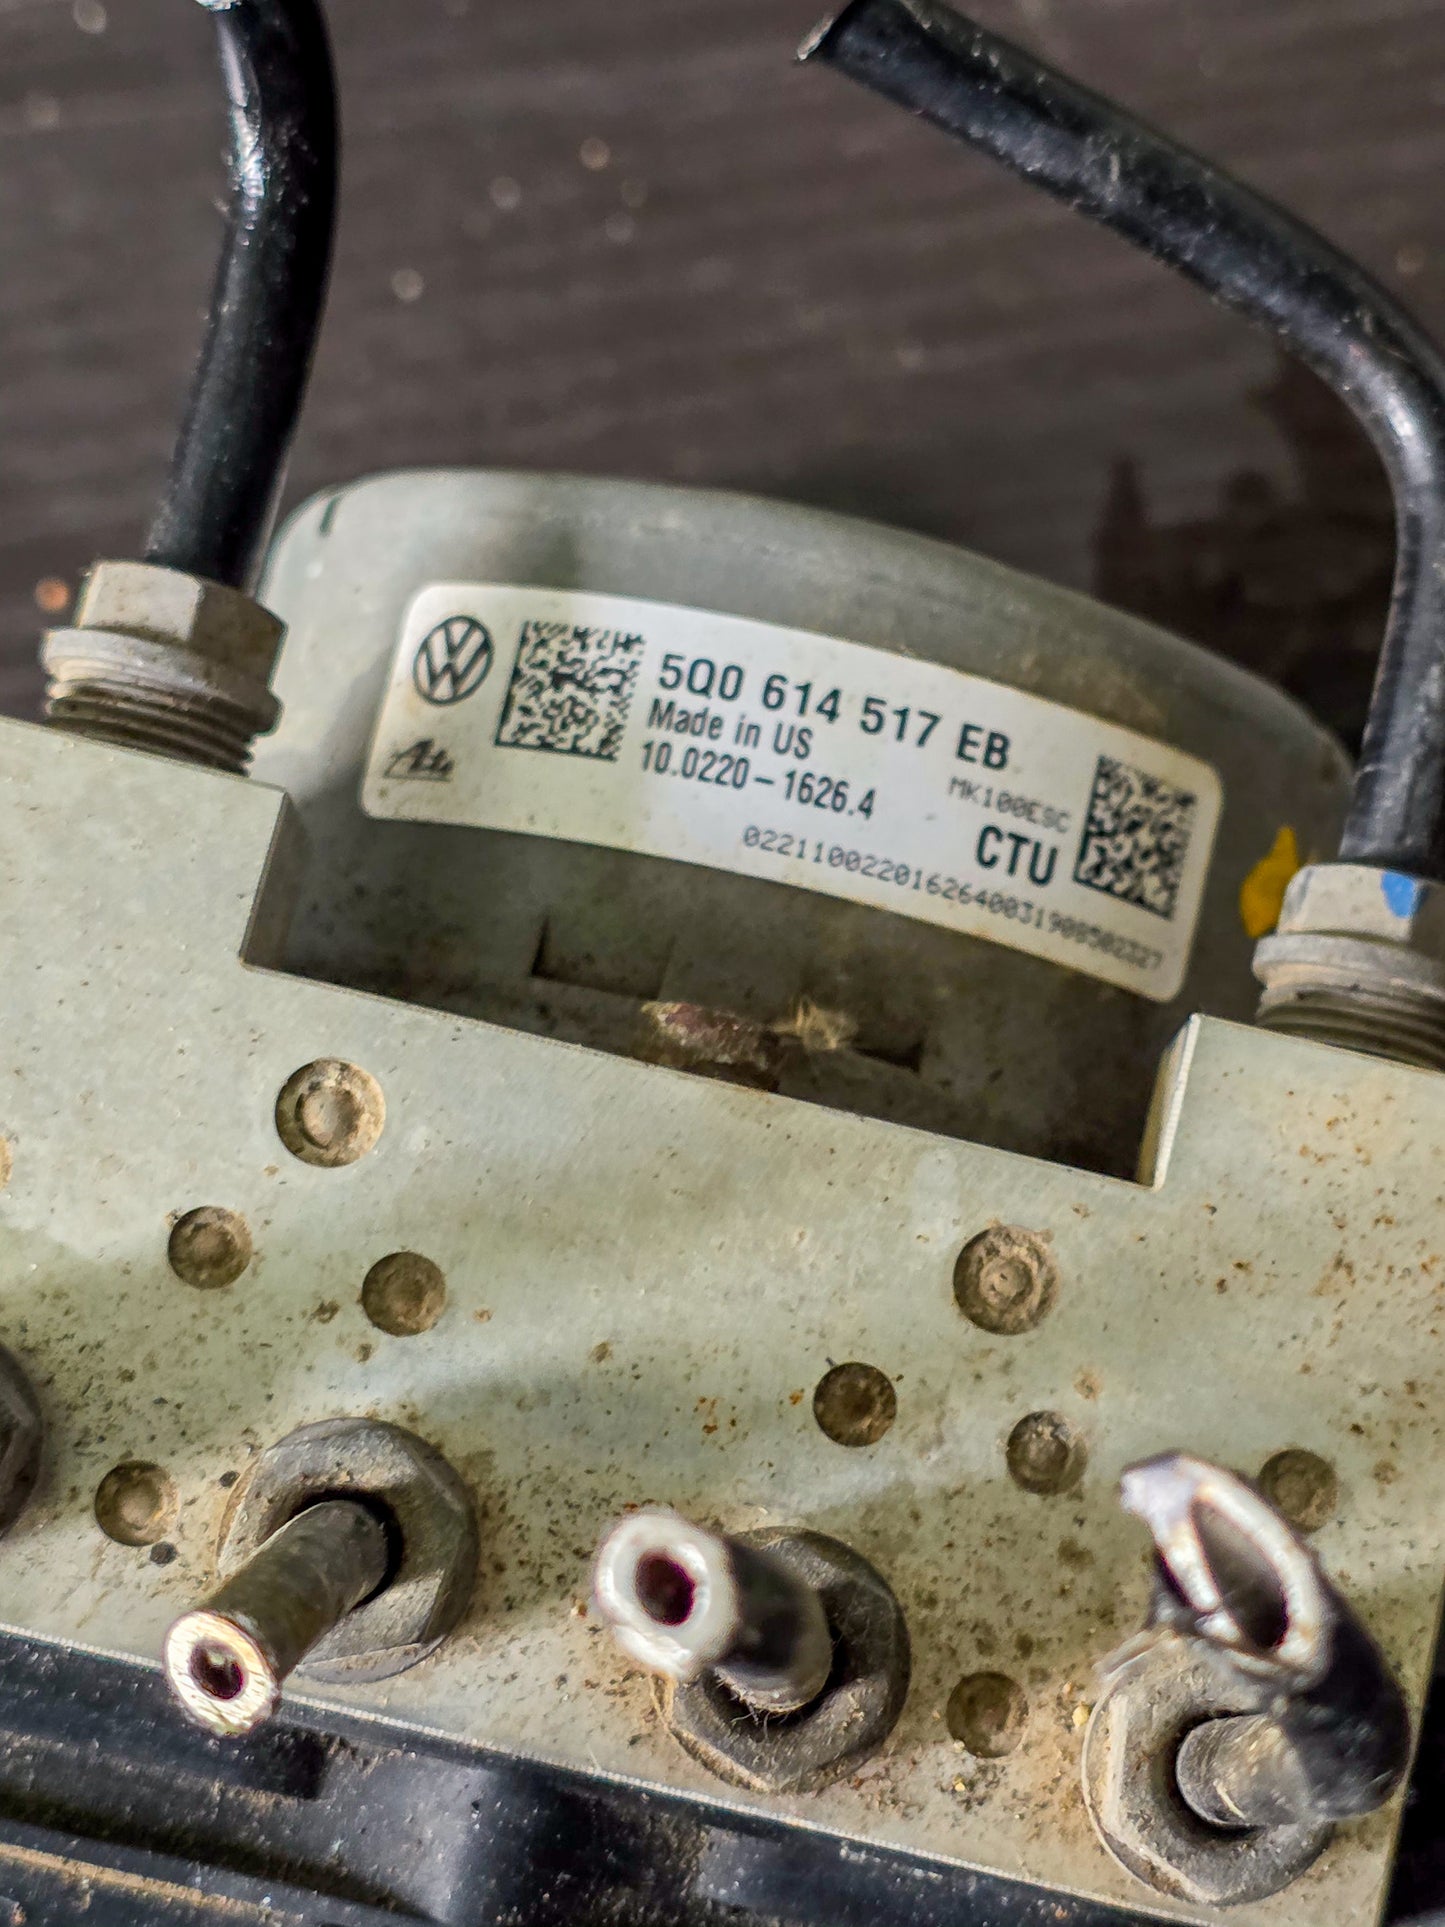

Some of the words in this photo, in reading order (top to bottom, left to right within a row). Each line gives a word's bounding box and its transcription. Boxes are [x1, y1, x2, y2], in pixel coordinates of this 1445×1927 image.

[648, 698, 723, 741] Made
[734, 713, 762, 748] in
[773, 722, 814, 760] US
[658, 653, 744, 701] 5Q0
[762, 673, 842, 724] 614
[860, 696, 943, 749] 517
[955, 723, 1011, 771] EB
[948, 775, 1071, 834] MK100ESC
[976, 825, 1058, 888] CTU
